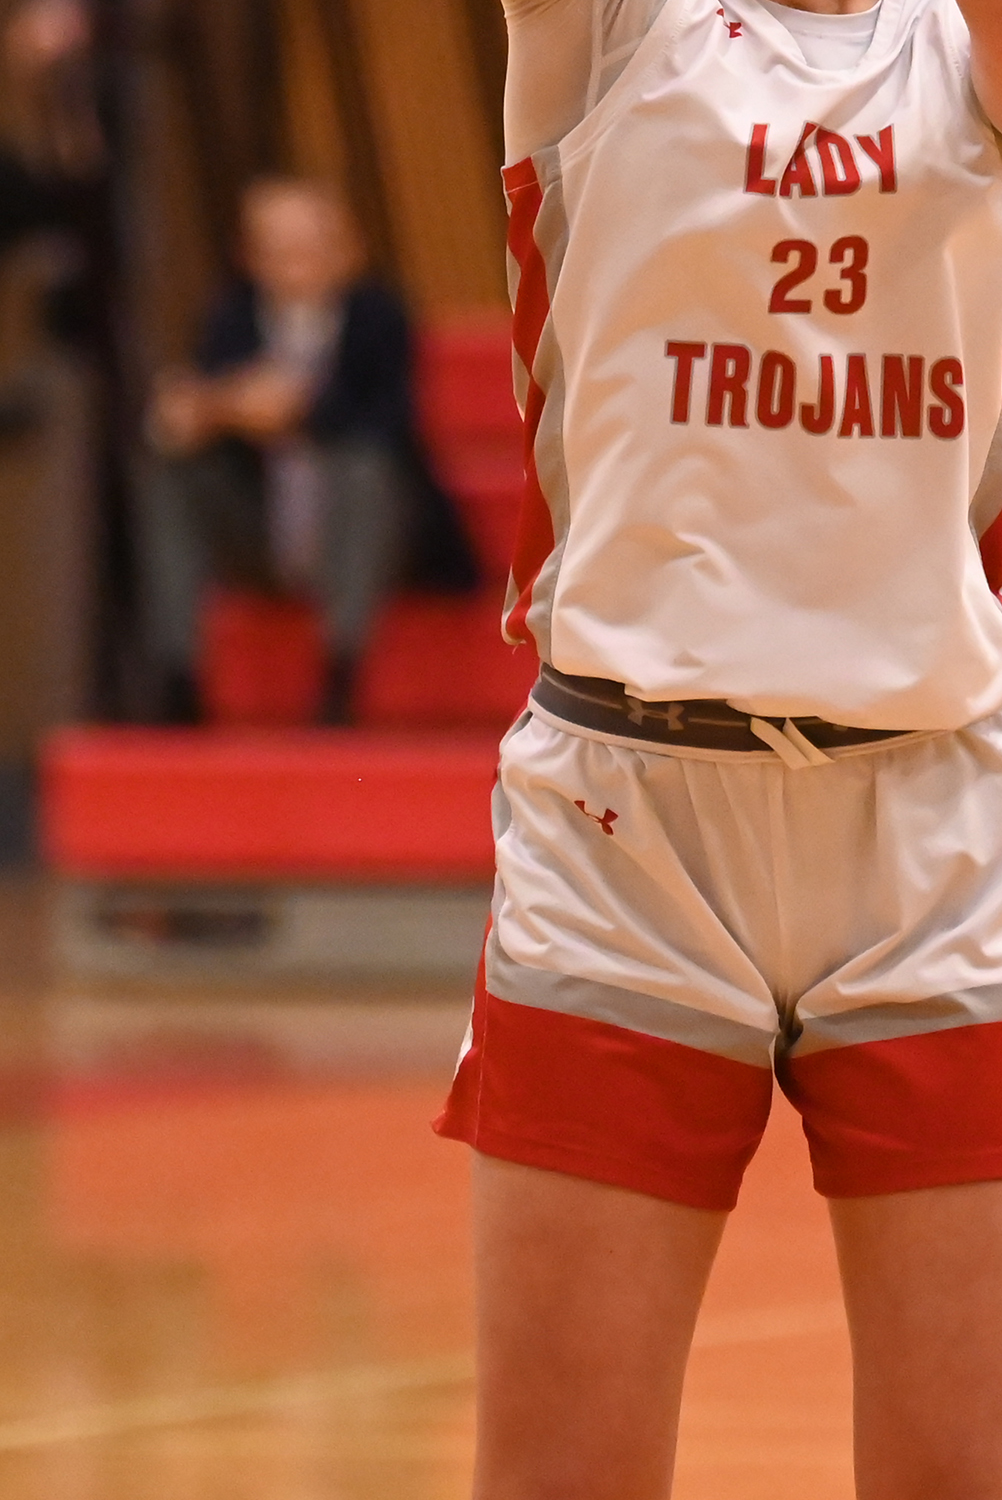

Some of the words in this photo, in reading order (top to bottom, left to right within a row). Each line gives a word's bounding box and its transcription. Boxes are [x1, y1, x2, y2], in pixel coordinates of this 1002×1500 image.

[743, 120, 898, 198] LADY
[768, 235, 869, 315] 23
[665, 339, 965, 440] TROJANS
